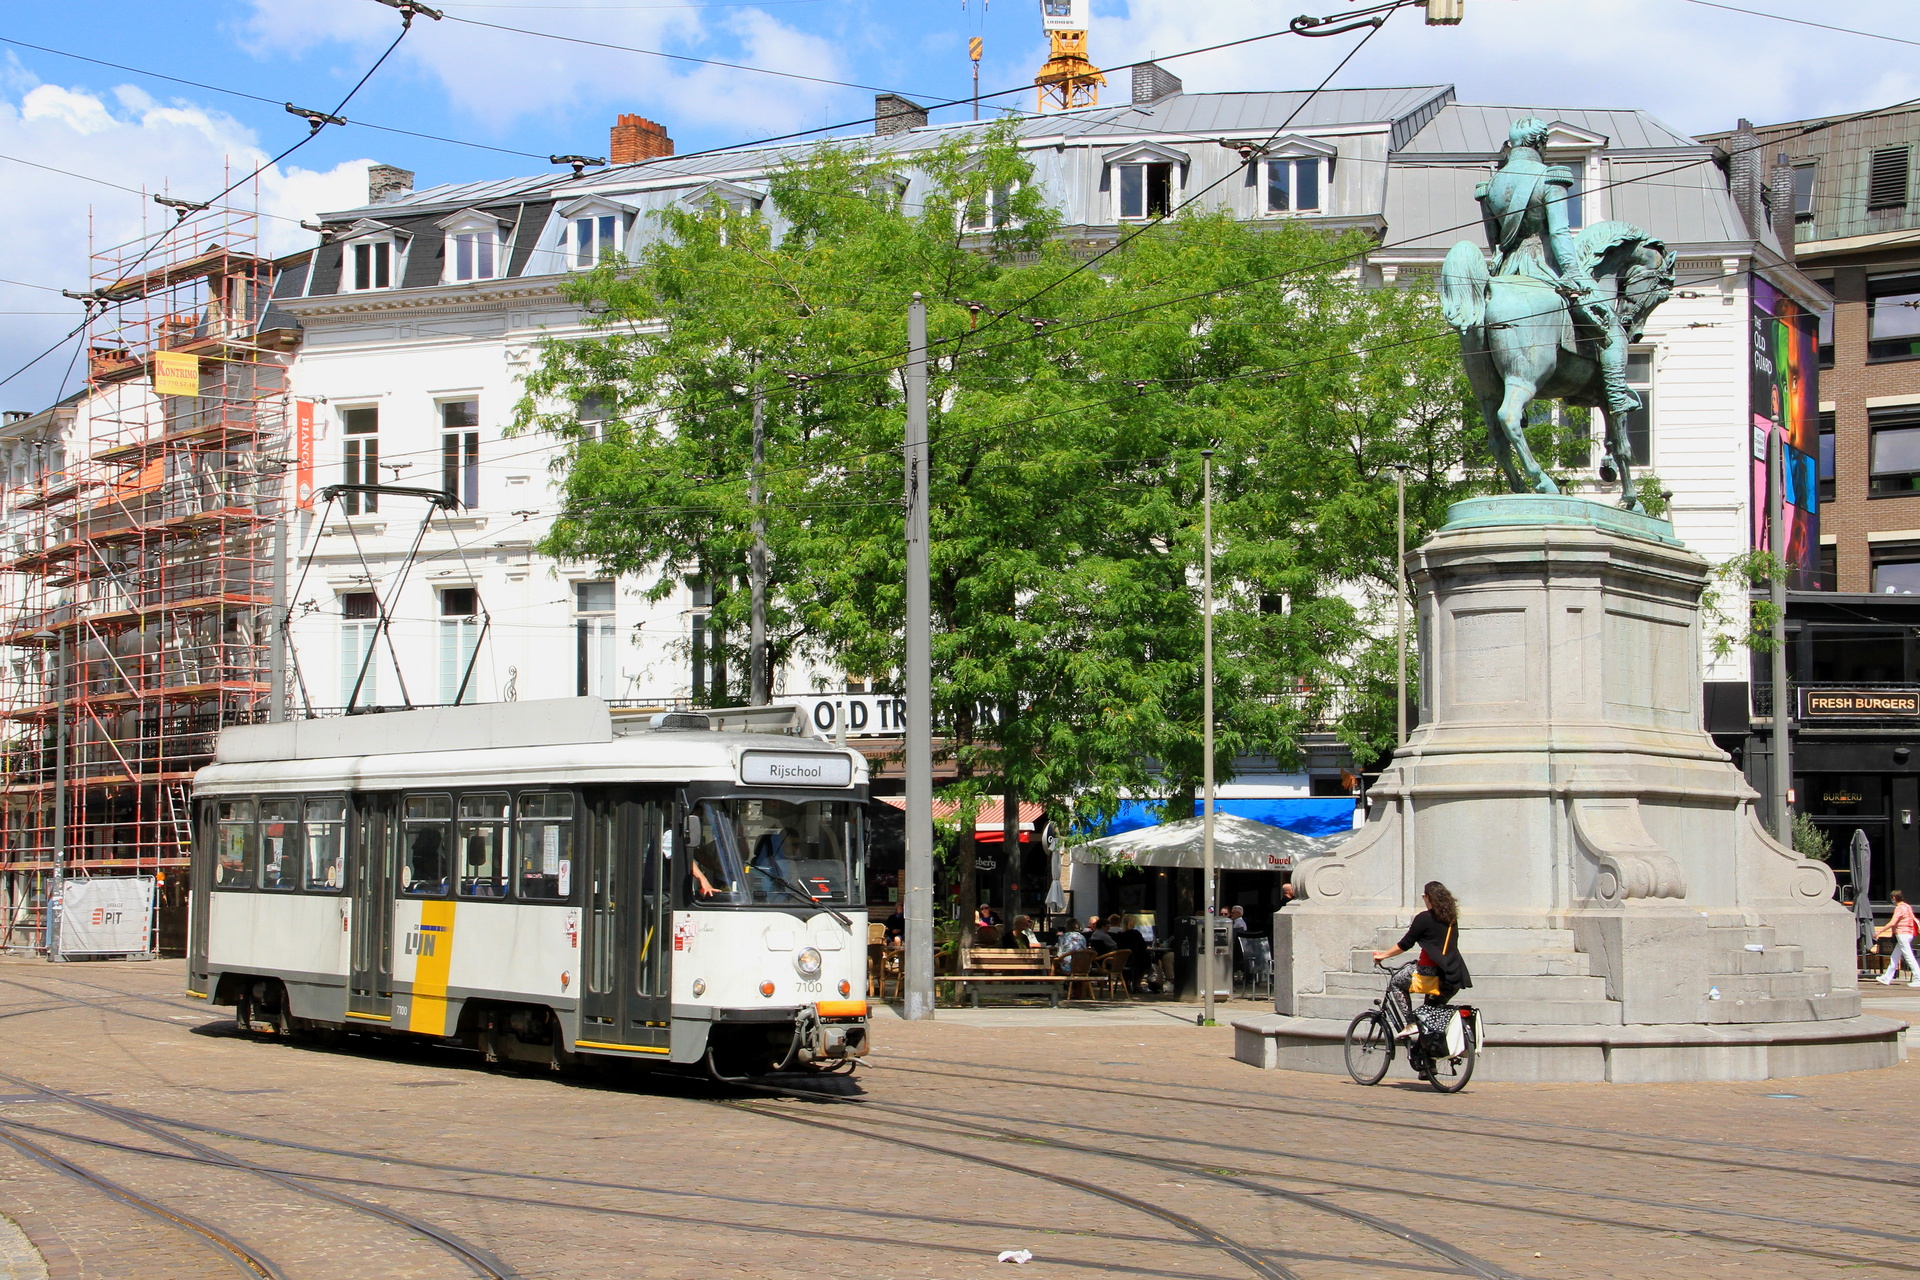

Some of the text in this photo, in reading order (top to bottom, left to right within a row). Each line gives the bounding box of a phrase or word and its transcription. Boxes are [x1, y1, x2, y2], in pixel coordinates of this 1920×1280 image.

[1754, 331, 1766, 351] OLD
[1754, 350, 1773, 375] GUARD
[1812, 698, 1916, 710] FRESH BURGERS
[814, 701, 868, 730] OD
[770, 764, 822, 779] Rijschool
[1268, 854, 1292, 865] Duvel
[105, 912, 123, 925] PIT
[795, 982, 823, 993] 7100
[396, 1005, 408, 1016] 7100
